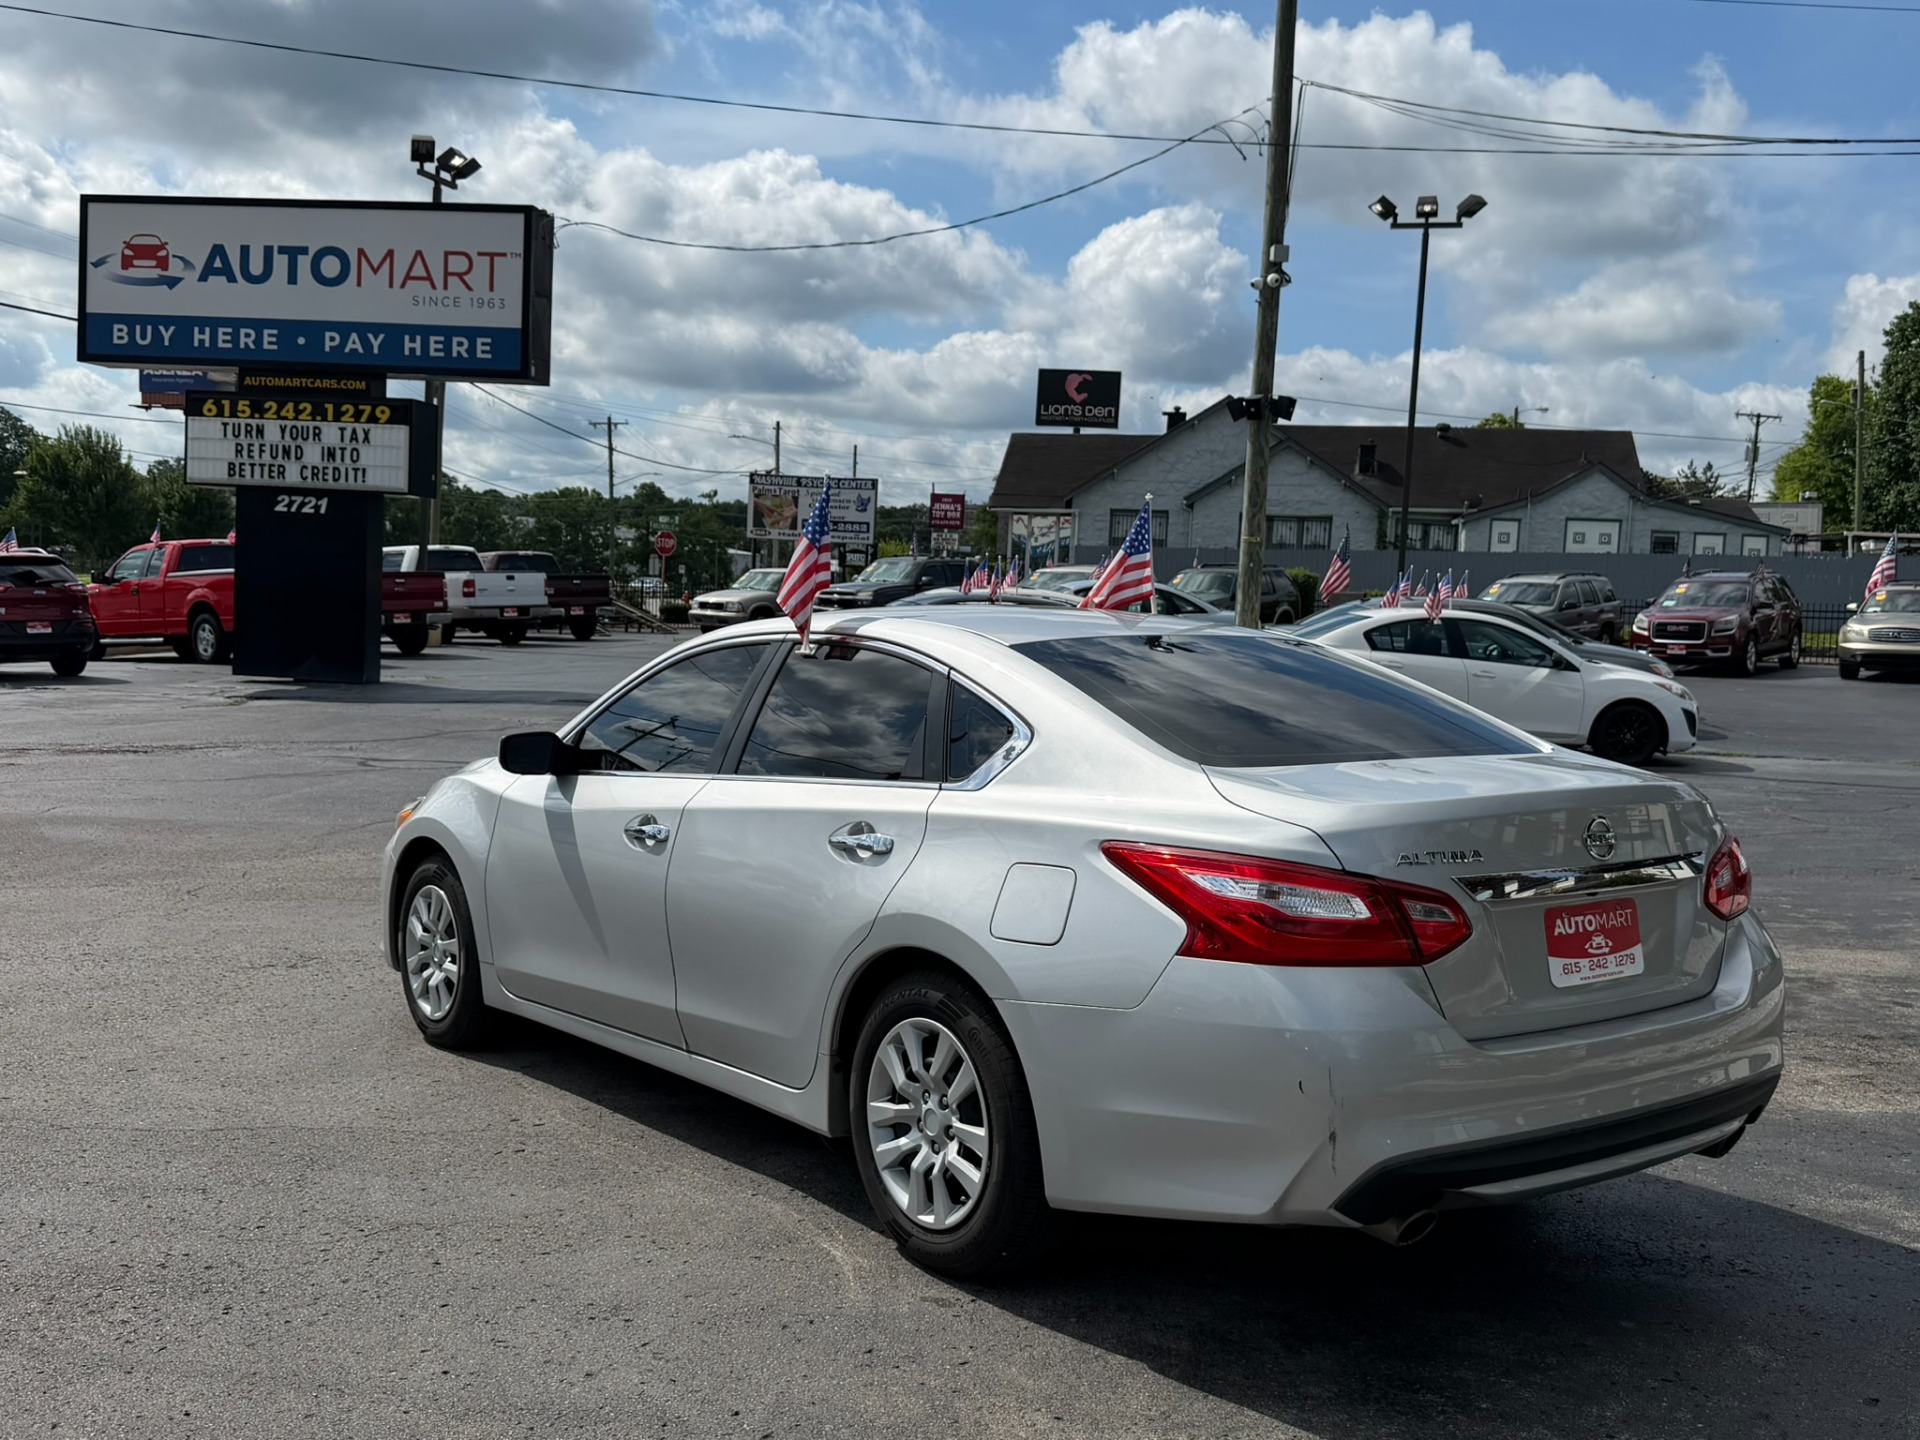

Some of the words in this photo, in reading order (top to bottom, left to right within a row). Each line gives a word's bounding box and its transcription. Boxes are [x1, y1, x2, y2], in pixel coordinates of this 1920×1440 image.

[197, 243, 508, 293] AUTOMART
[412, 295, 461, 308] SINCE
[469, 297, 506, 310] 1963
[112, 323, 176, 346] BUY
[193, 326, 279, 350] HERE
[324, 331, 386, 354] PAY
[404, 334, 492, 359] HERE
[243, 376, 366, 390] AUTOMARTCARS.COM
[202, 398, 391, 424] 615.242.1279
[221, 422, 265, 440] TURN
[279, 424, 322, 442] YOUR
[338, 427, 371, 444] TAX
[235, 443, 304, 461] REFUND
[321, 446, 360, 463] INTO
[227, 462, 286, 480] BETTER
[299, 465, 367, 483] CREDIT!
[800, 478, 838, 488] PSYCC
[274, 494, 329, 514] 2721
[656, 538, 675, 549] STOP
[1396, 849, 1485, 867] ALTIMA
[1553, 908, 1633, 936] AUTOMART
